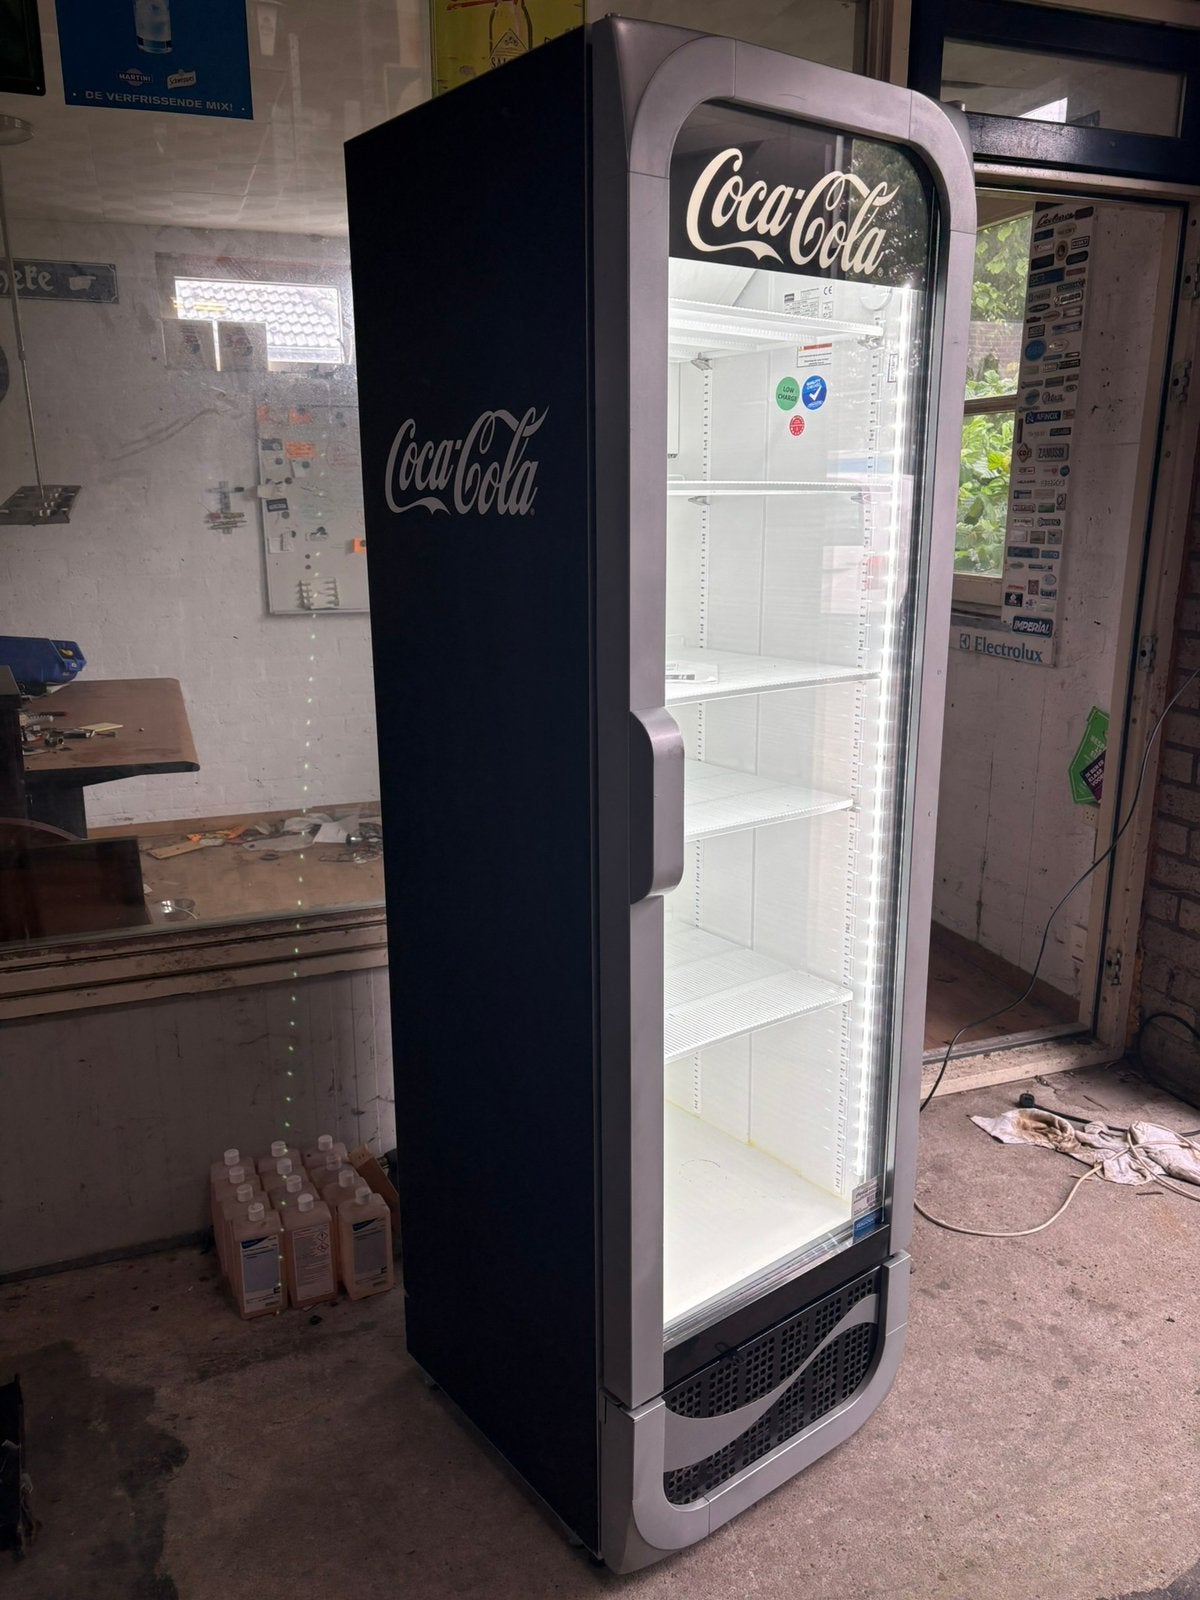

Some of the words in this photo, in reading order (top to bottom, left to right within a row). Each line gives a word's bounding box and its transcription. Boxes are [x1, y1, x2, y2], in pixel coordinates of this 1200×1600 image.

[118, 73, 151, 83] MARTINI
[85, 90, 103, 100] DE
[106, 91, 203, 109] VERFRISSENDE
[206, 101, 233, 112] MIX!
[686, 147, 900, 275] Coca-Cola
[782, 385, 795, 394] LOW
[777, 393, 798, 402] CHARGE
[1036, 412, 1059, 421] AFINOX
[1038, 447, 1065, 459] ZANUSSI
[384, 405, 550, 516] Coca-Cola
[974, 635, 1043, 662] Electrolux
